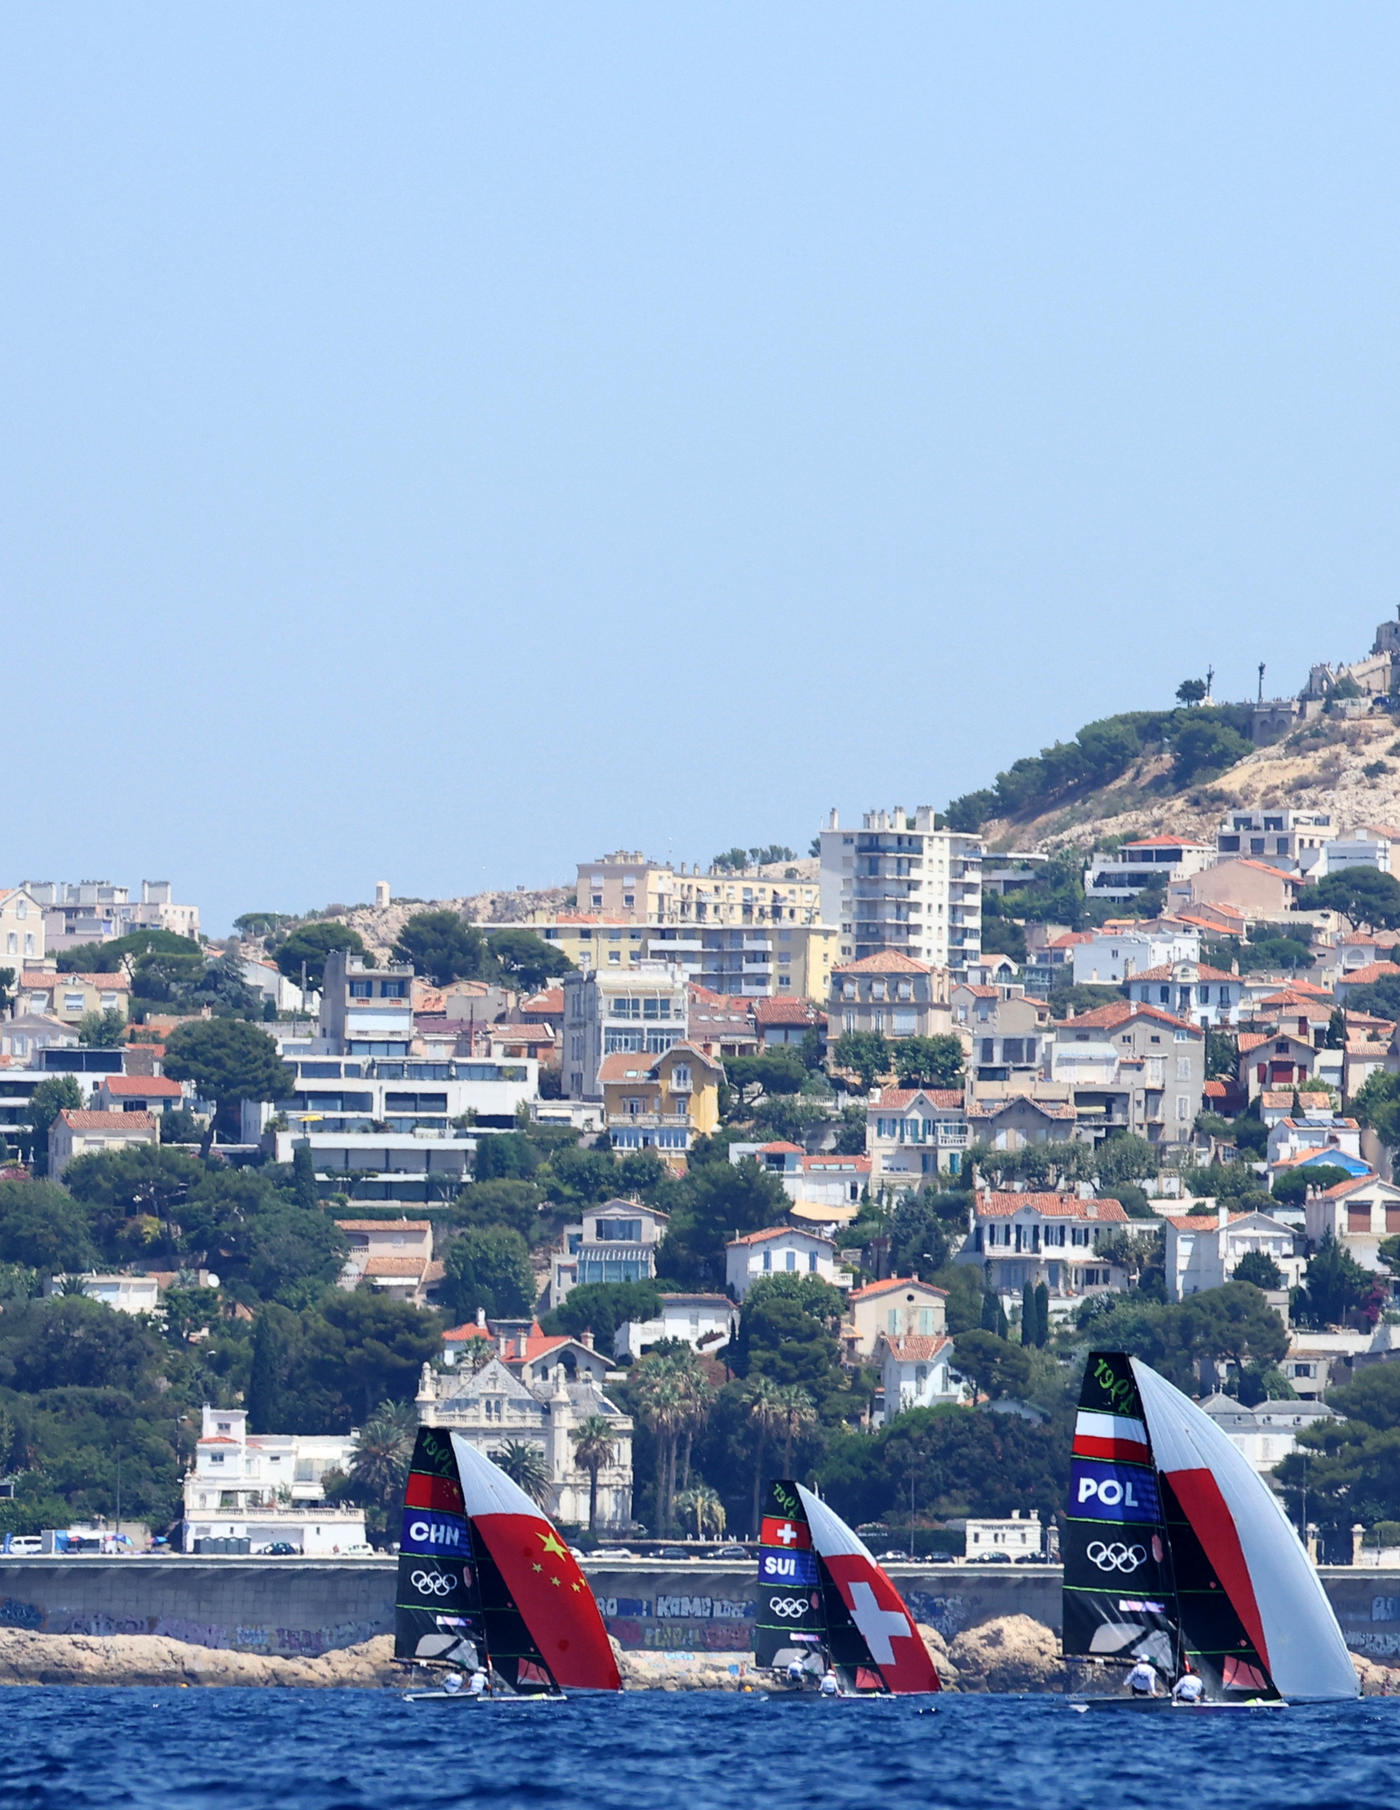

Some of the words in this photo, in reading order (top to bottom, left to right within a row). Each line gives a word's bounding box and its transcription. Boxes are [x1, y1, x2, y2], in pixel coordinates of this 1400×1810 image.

[1078, 1477, 1139, 1507] POL
[410, 1521, 460, 1546] CHN
[764, 1556, 796, 1576] SUI
